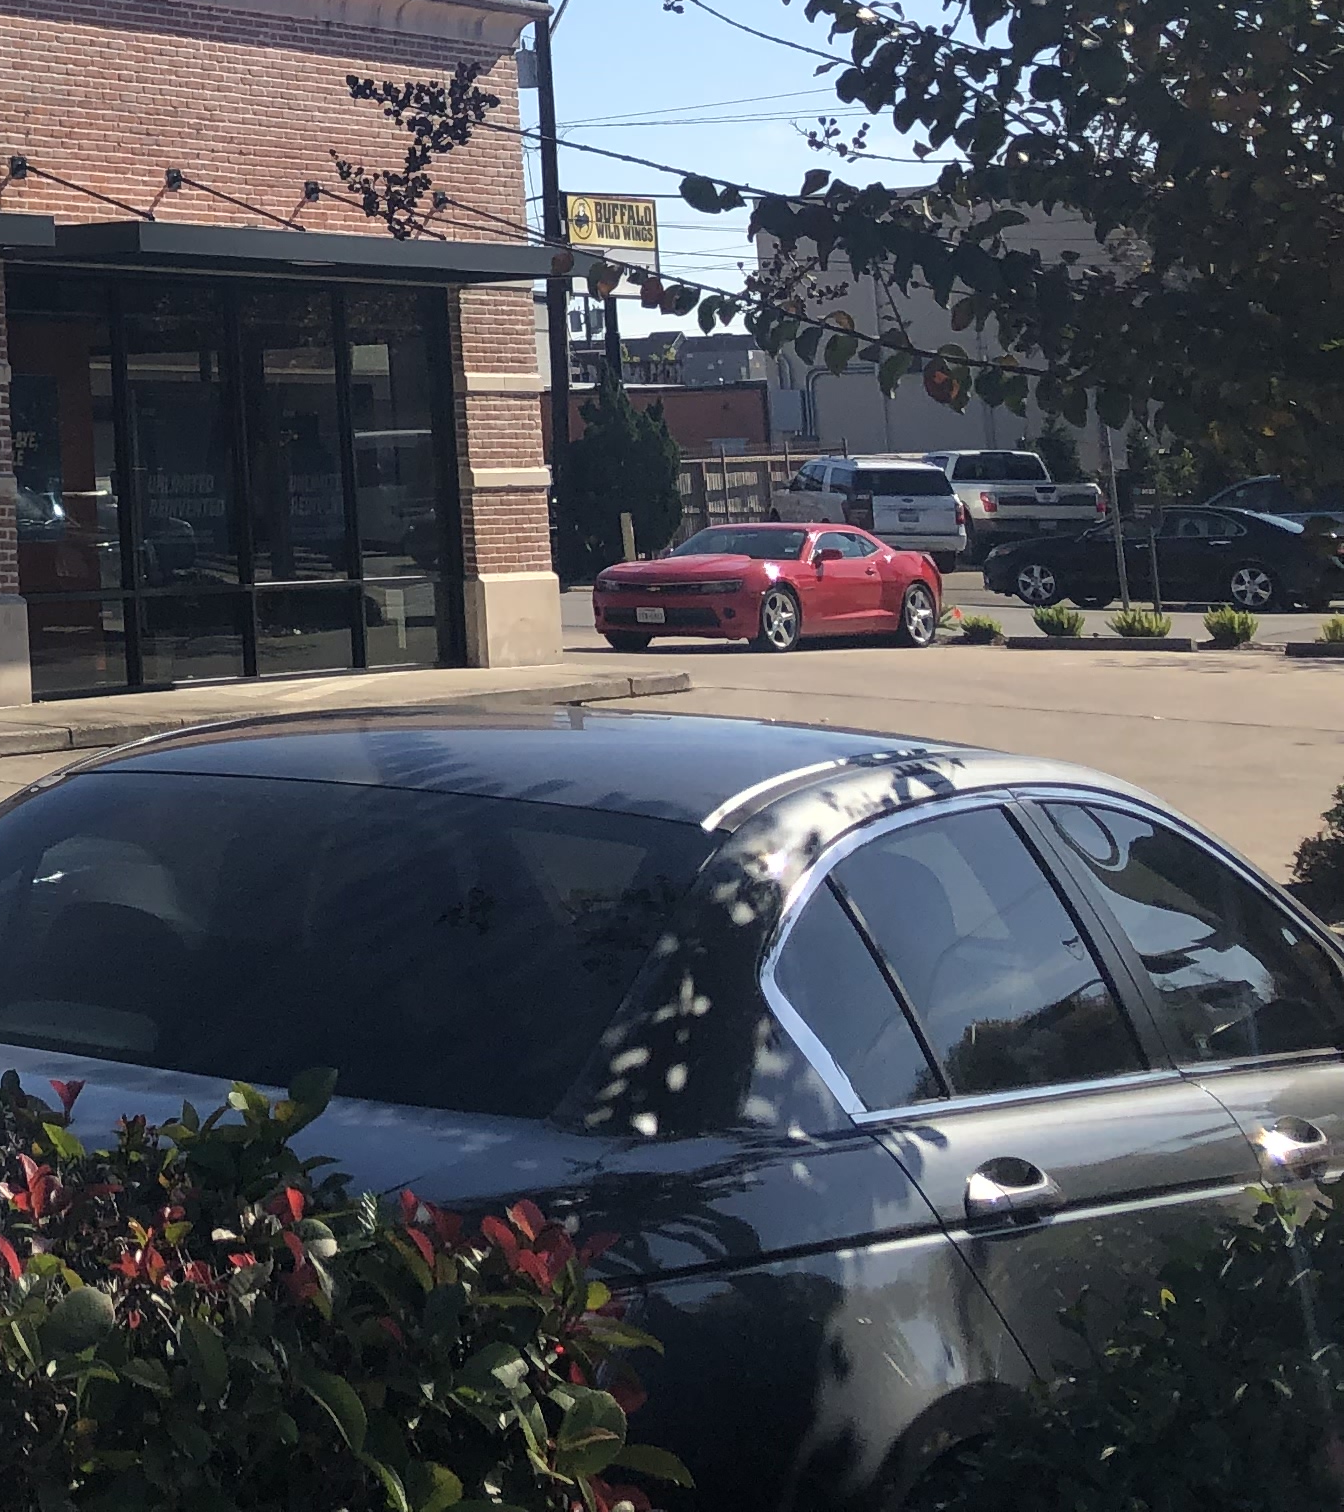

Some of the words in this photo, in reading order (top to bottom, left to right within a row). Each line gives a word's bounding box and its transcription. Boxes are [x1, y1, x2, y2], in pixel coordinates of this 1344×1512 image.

[594, 201, 652, 226] BUFFALO
[596, 223, 620, 240] WILD
[621, 226, 654, 243] WINGS
